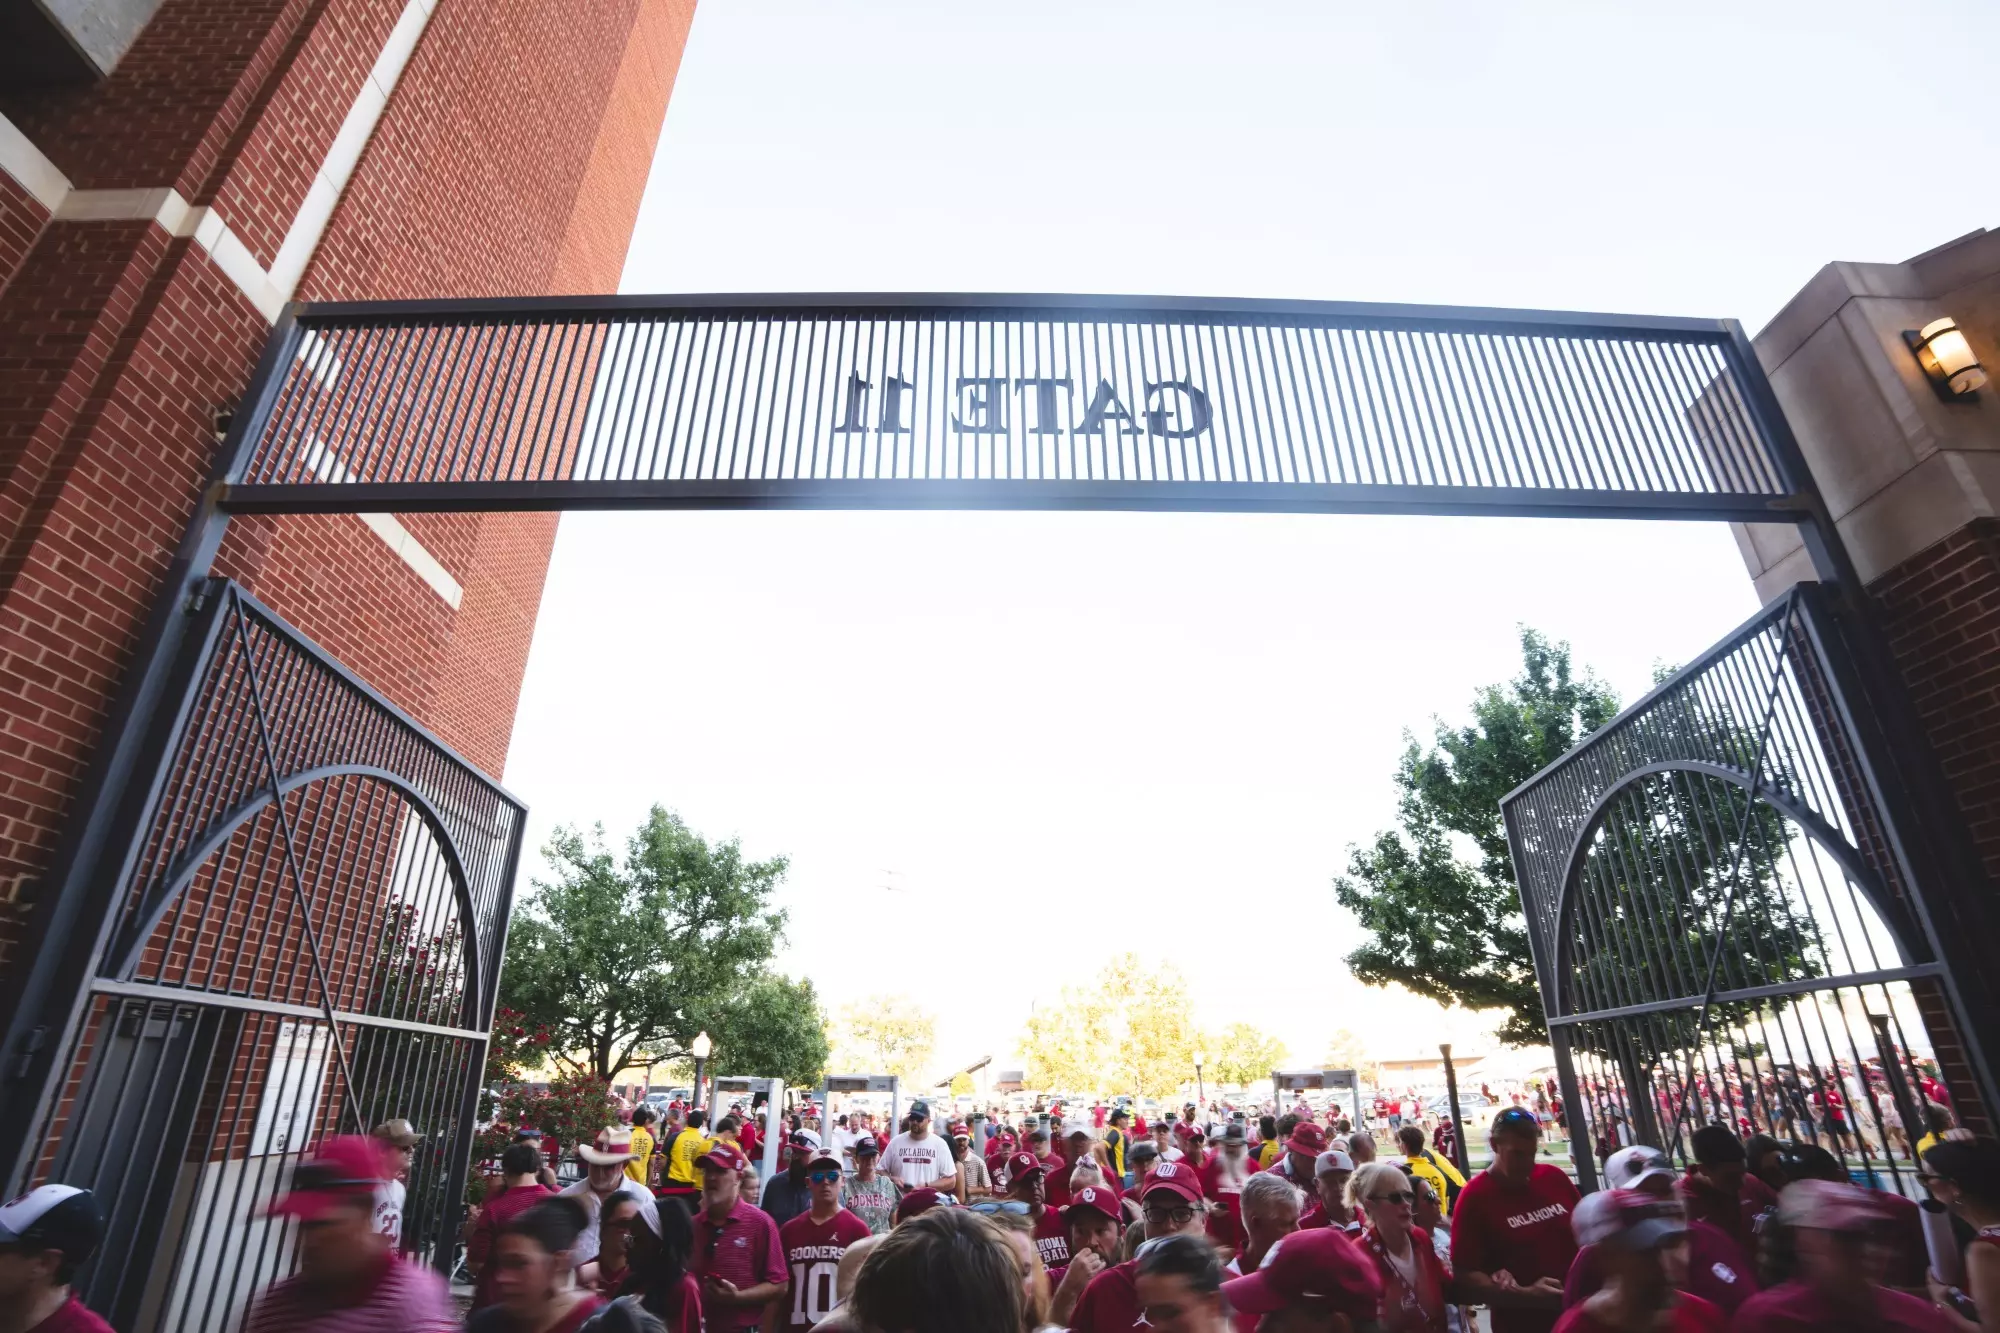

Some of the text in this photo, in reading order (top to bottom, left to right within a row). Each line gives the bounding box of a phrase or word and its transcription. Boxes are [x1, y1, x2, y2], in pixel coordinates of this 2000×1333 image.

[898, 1147, 936, 1158] OKLAHOMA
[847, 1194, 893, 1213] SOONERS
[1082, 1187, 1096, 1203] OU
[1506, 1202, 1569, 1229] OKLAHOMA
[789, 1245, 846, 1261] SOONERS
[791, 1261, 840, 1326] 10
